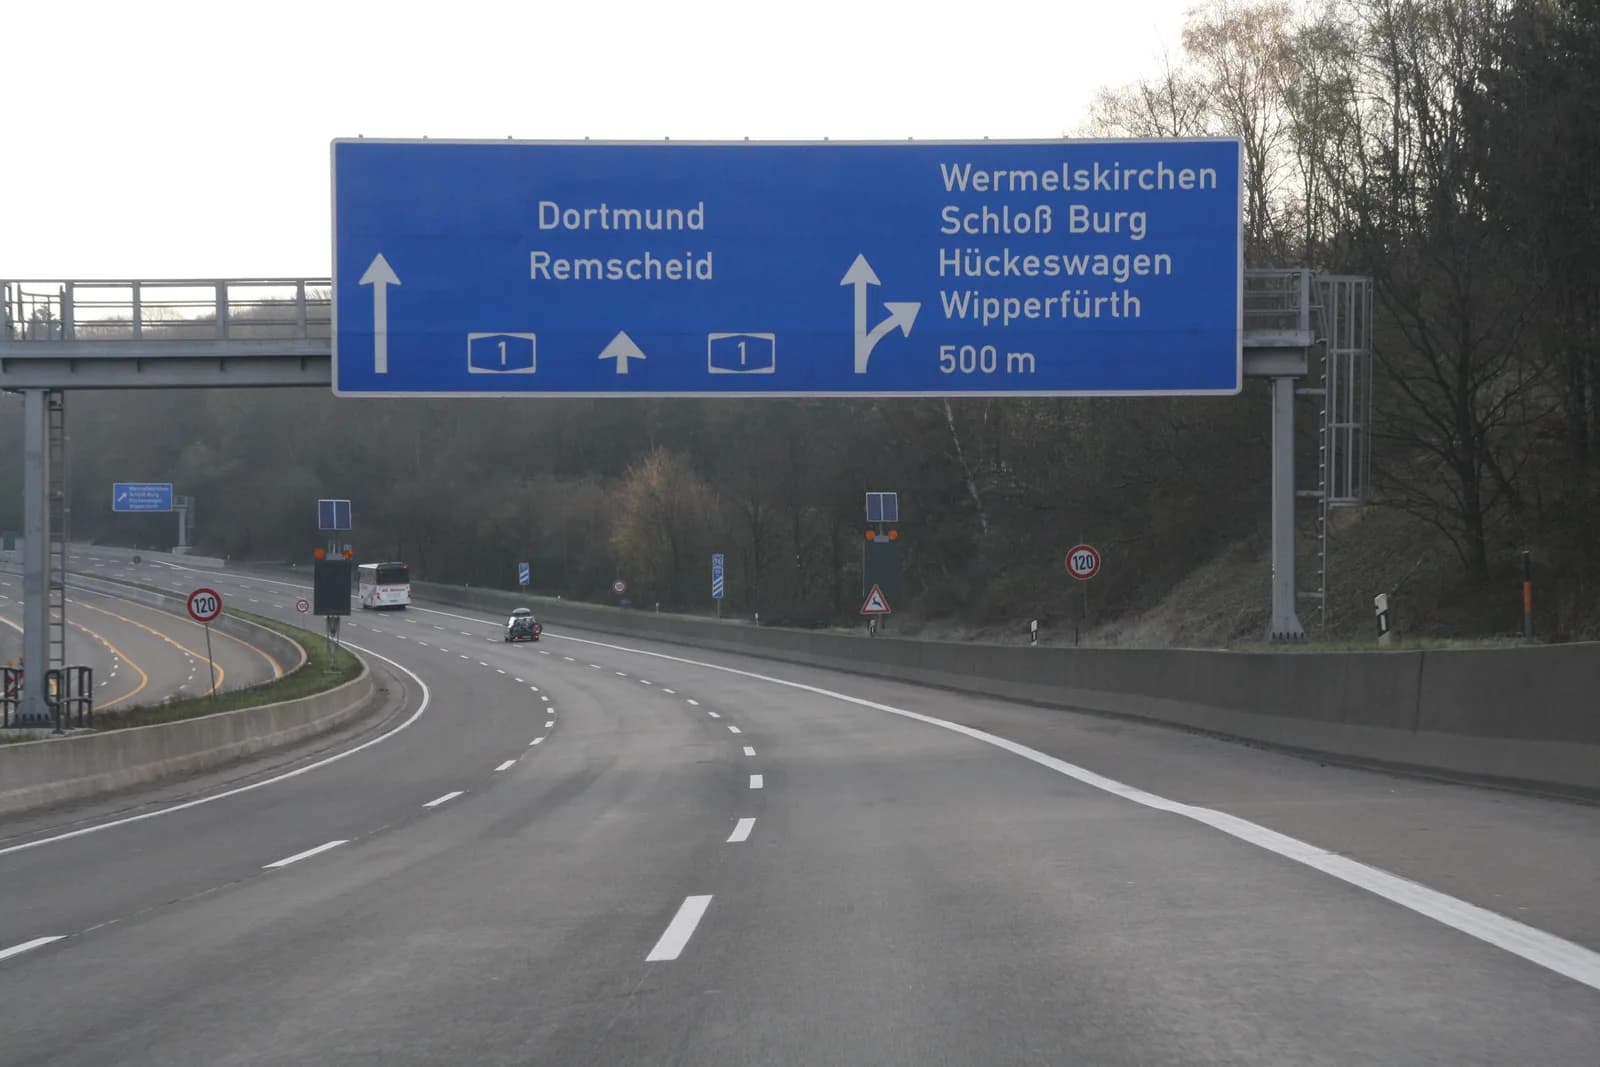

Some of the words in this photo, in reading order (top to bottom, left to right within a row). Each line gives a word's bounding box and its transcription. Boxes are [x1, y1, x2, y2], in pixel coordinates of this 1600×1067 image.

[940, 161, 1217, 192] Wermelskirchen
[538, 201, 704, 230] Dortmund
[941, 205, 1052, 235] Schloß
[1069, 204, 1147, 240] Burg
[530, 251, 713, 280] Remscheid
[939, 247, 1172, 283] Hückeswagen
[940, 289, 1141, 326] Wipperfürth
[497, 341, 507, 365] 1
[737, 341, 747, 365] 1
[939, 345, 997, 373] 500
[1007, 352, 1035, 373] m
[1073, 555, 1094, 571] 120
[194, 597, 216, 614] 120
